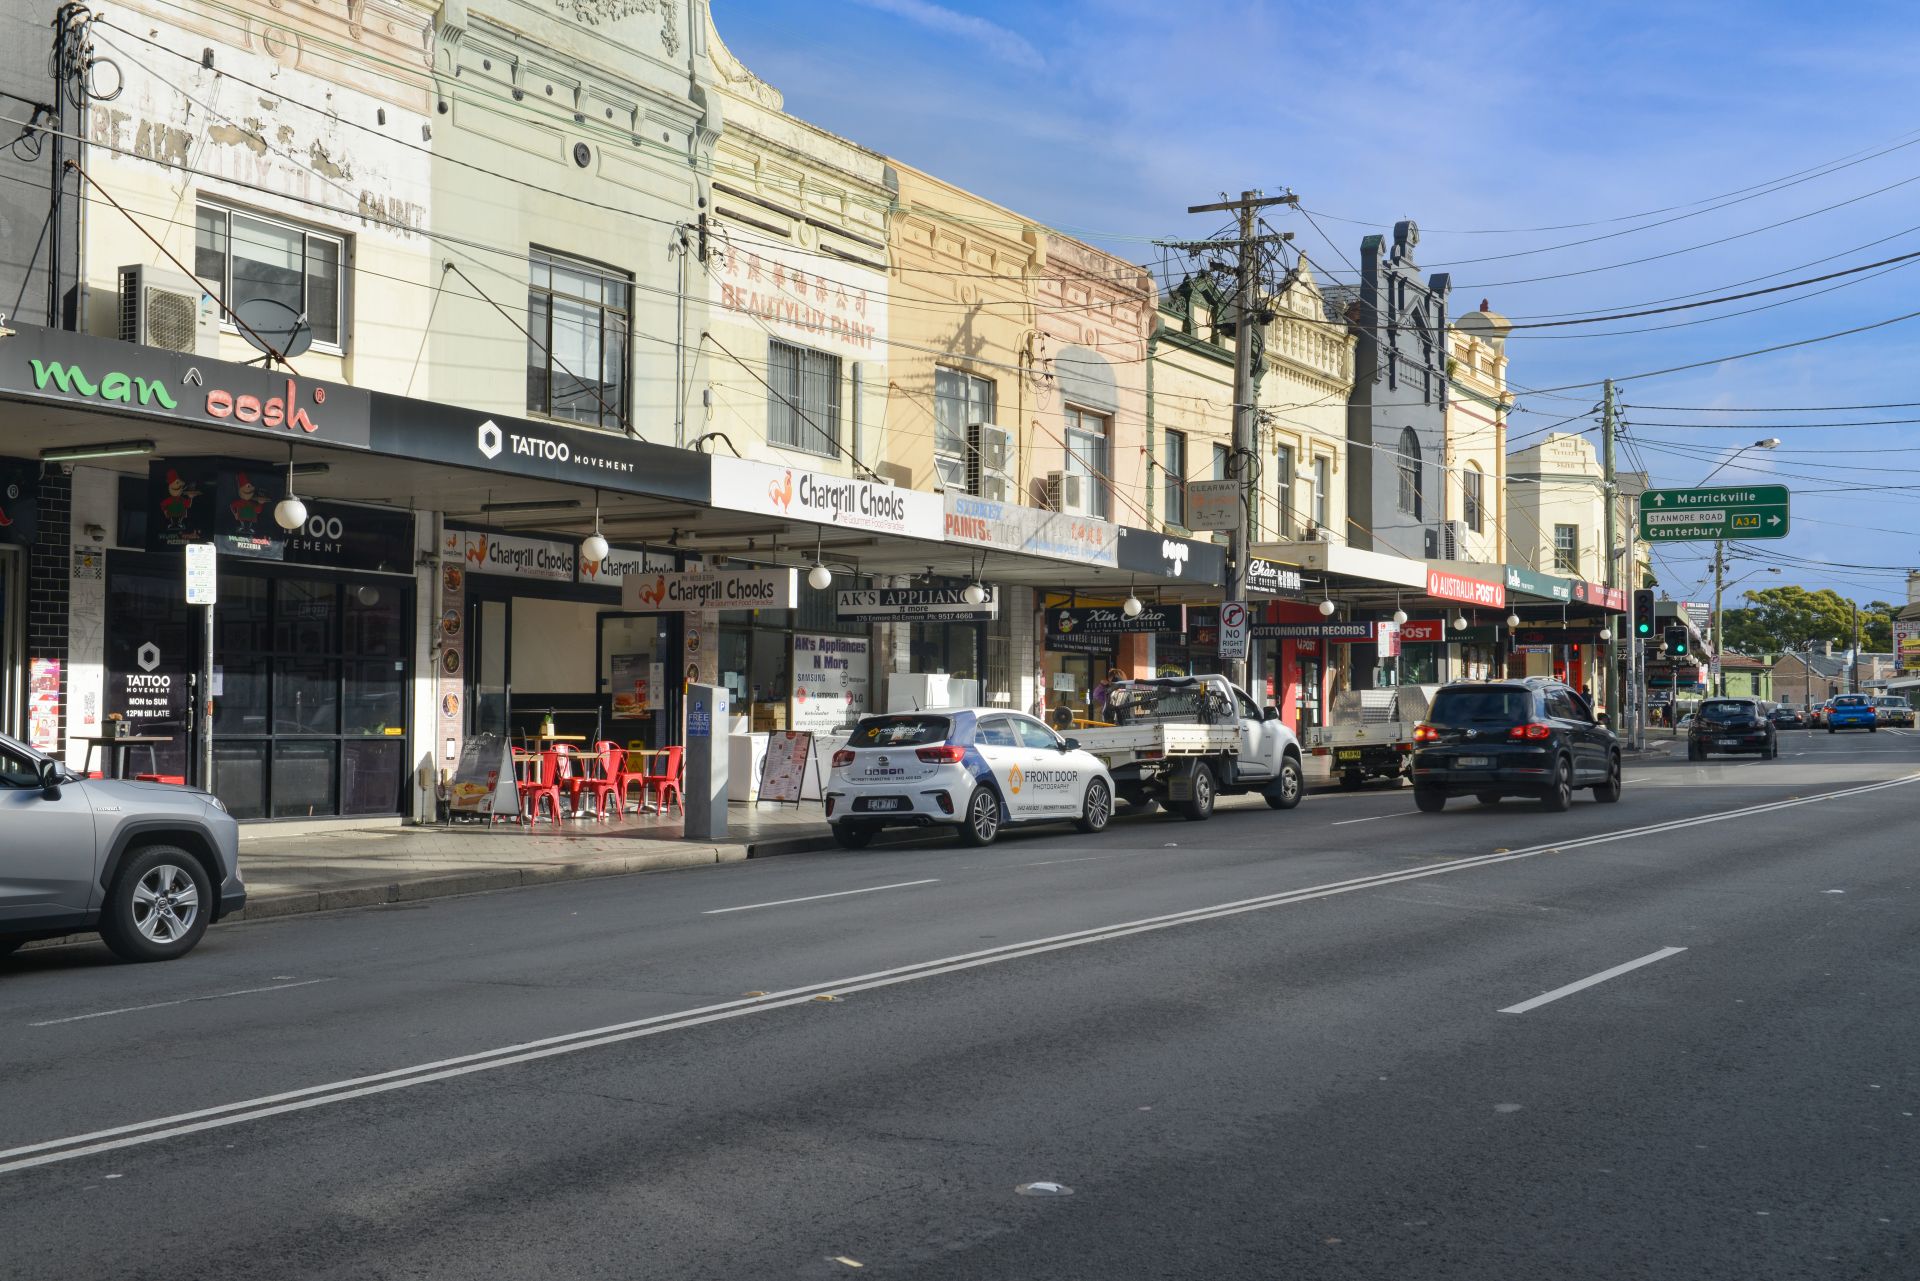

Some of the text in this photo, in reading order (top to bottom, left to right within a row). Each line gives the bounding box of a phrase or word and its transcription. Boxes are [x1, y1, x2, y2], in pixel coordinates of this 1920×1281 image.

[721, 282, 875, 350] BEAUTYLUX PAINT
[29, 359, 319, 433] man oosh
[510, 434, 635, 473] TATTOO MOVEMENT
[1190, 484, 1236, 492] CLEARWAY
[799, 473, 904, 522] Chargrill Chooks
[1677, 492, 1756, 504] Marrickville
[1650, 512, 1723, 523] STANMORE ROAD
[1735, 517, 1757, 526] A34
[945, 513, 986, 541] PAINTS
[1649, 527, 1723, 538] Canterbury
[237, 542, 261, 550] PIZZERIA
[490, 542, 573, 572] Chargrill Chooks
[601, 555, 640, 576] Chargrill
[669, 578, 774, 606] Chargrill Chooks
[840, 587, 991, 606] AK'S APPLIANCS
[1440, 579, 1495, 603] AUSTRALIA POST
[1086, 609, 1118, 622] Xin
[1086, 620, 1166, 629] VIETNAMESE CUISINE
[1252, 625, 1366, 636] COTTONMOUTH RECORDS
[1225, 629, 1240, 639] NO
[794, 635, 866, 654] AK's Appliances
[1303, 641, 1316, 651] POST
[813, 655, 848, 669] N More
[126, 675, 171, 687] TATTOO
[797, 673, 826, 682] SAMSUNG
[854, 694, 864, 703] LG
[695, 702, 702, 711] P
[720, 702, 726, 711] P
[688, 713, 709, 722] FREE
[1024, 770, 1079, 783] FRONT DOOR
